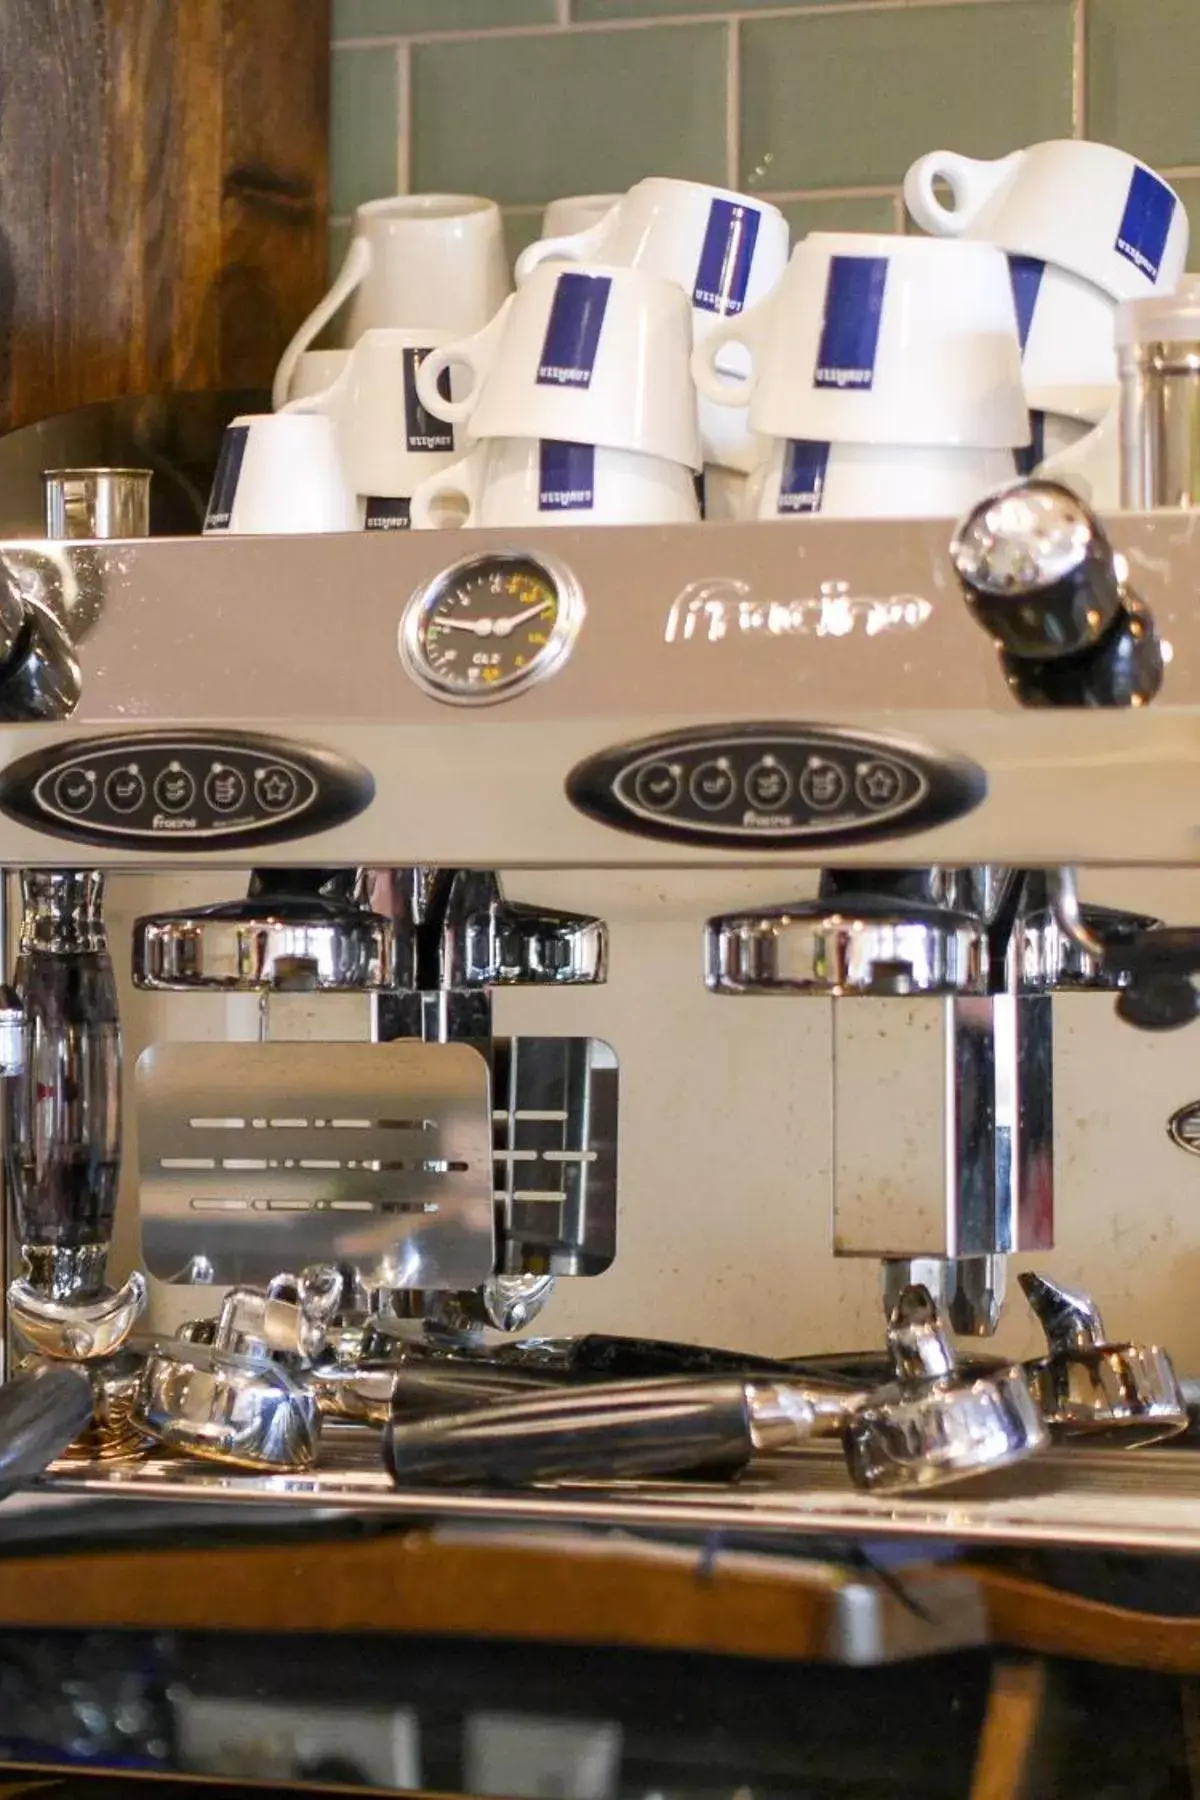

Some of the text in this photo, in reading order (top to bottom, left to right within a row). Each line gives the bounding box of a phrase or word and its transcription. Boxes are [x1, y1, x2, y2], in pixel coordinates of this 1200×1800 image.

[1117, 237, 1157, 277] LAVAZZA
[539, 365, 590, 383] LAVAZZA
[814, 368, 872, 386] LAVAZZA
[408, 435, 451, 449] LAVAZZA
[539, 489, 591, 506] LAVAZZA
[366, 517, 408, 530] LAVAZZA
